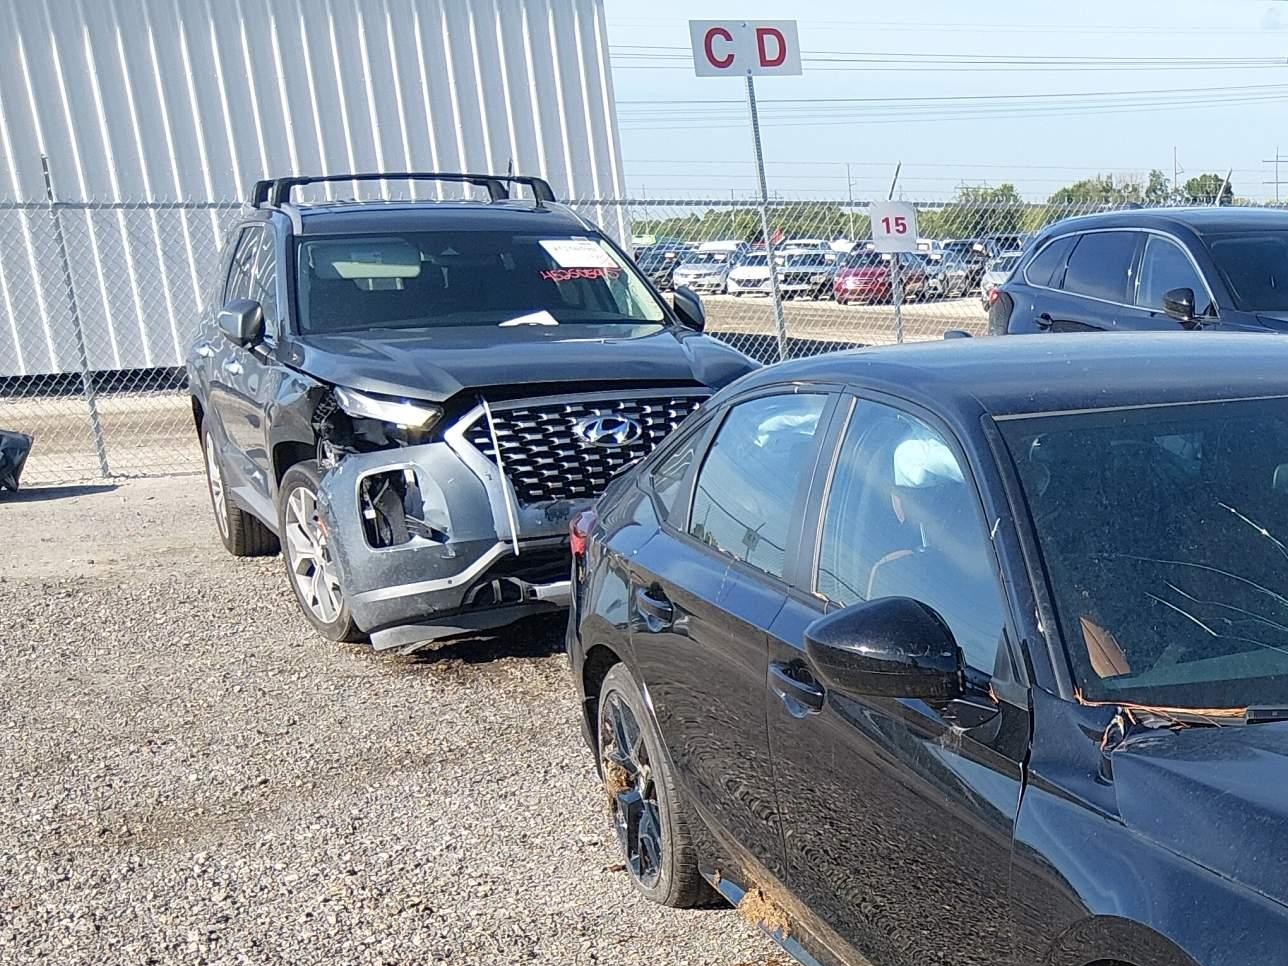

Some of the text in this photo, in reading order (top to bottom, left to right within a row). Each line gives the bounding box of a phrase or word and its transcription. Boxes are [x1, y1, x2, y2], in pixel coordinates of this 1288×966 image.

[703, 27, 788, 69] C D
[881, 216, 907, 235] 15
